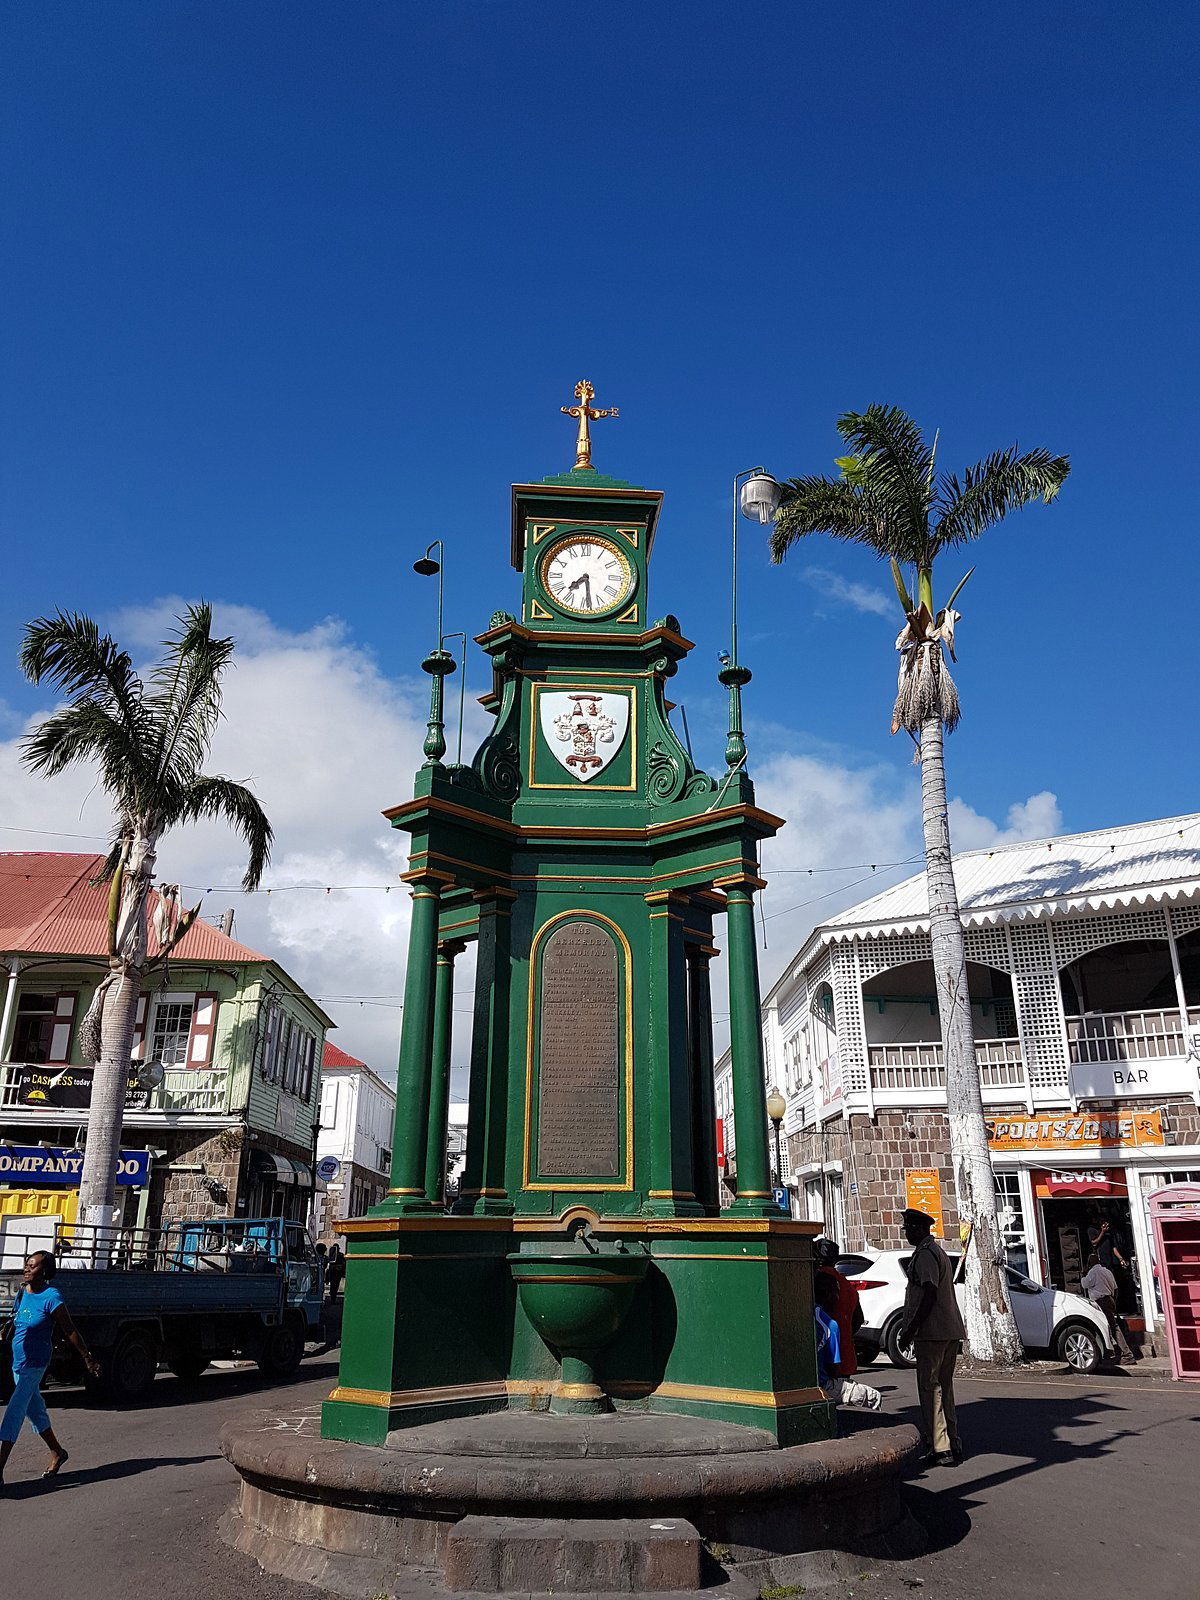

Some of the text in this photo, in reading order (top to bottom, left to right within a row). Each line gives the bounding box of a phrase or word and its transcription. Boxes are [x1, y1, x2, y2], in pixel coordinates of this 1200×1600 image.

[73, 1079, 91, 1087] today
[1114, 1069, 1149, 1084] BAR
[132, 1091, 148, 1099] 2729
[0, 1155, 82, 1173] OMPANY
[775, 1190, 783, 1203] P
